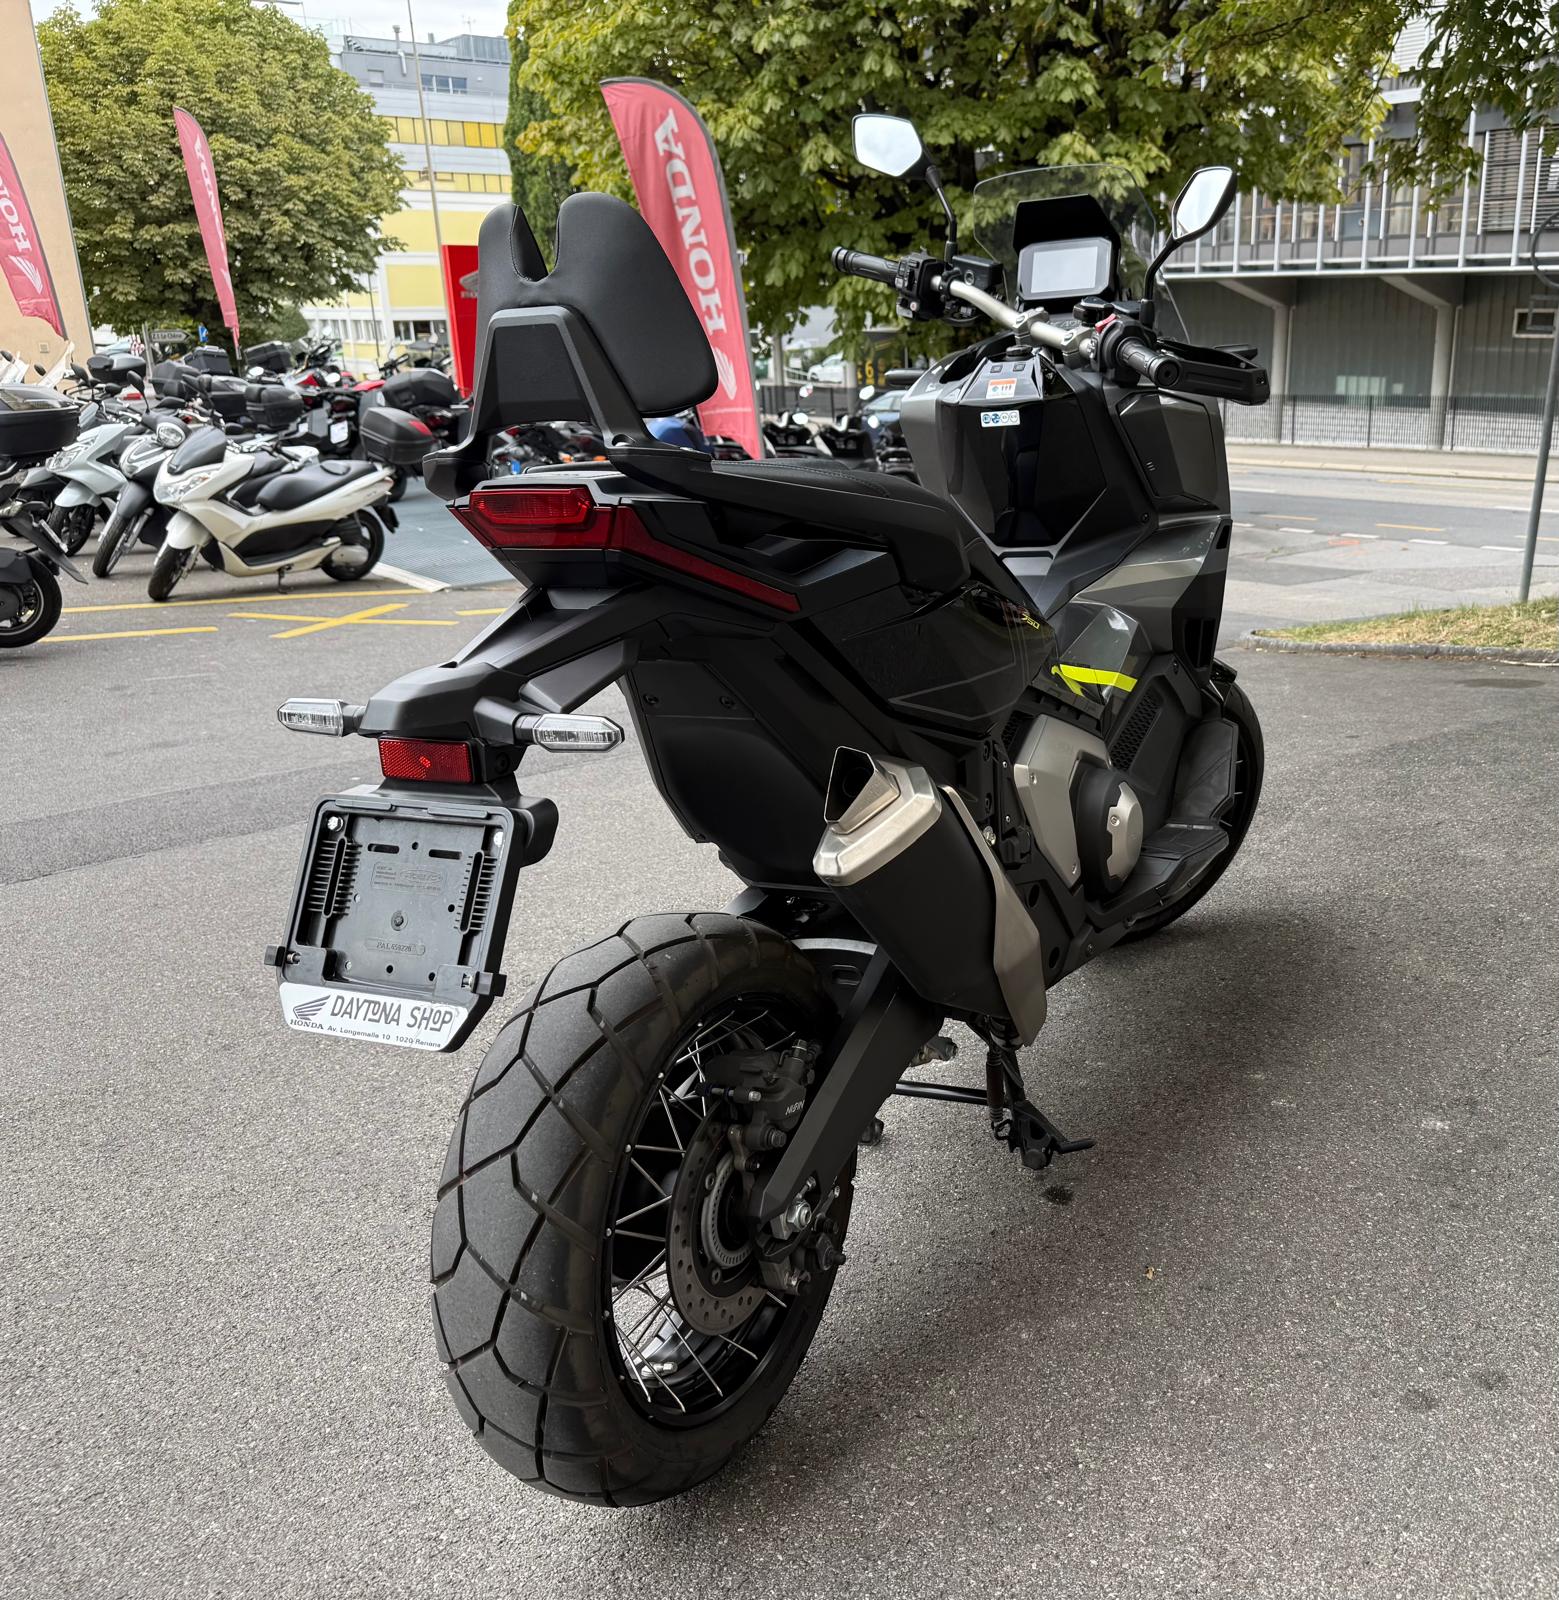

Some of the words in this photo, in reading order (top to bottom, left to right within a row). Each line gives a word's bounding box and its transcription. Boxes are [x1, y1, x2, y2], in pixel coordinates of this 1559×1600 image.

[654, 108, 727, 335] HONDA
[290, 1019, 324, 1030] HONDA
[330, 995, 402, 1027] DAYTONA
[406, 1006, 454, 1032] SHOP
[327, 1025, 338, 1033] Av.
[382, 1033, 391, 1041] 10
[396, 1035, 414, 1044] 1020
